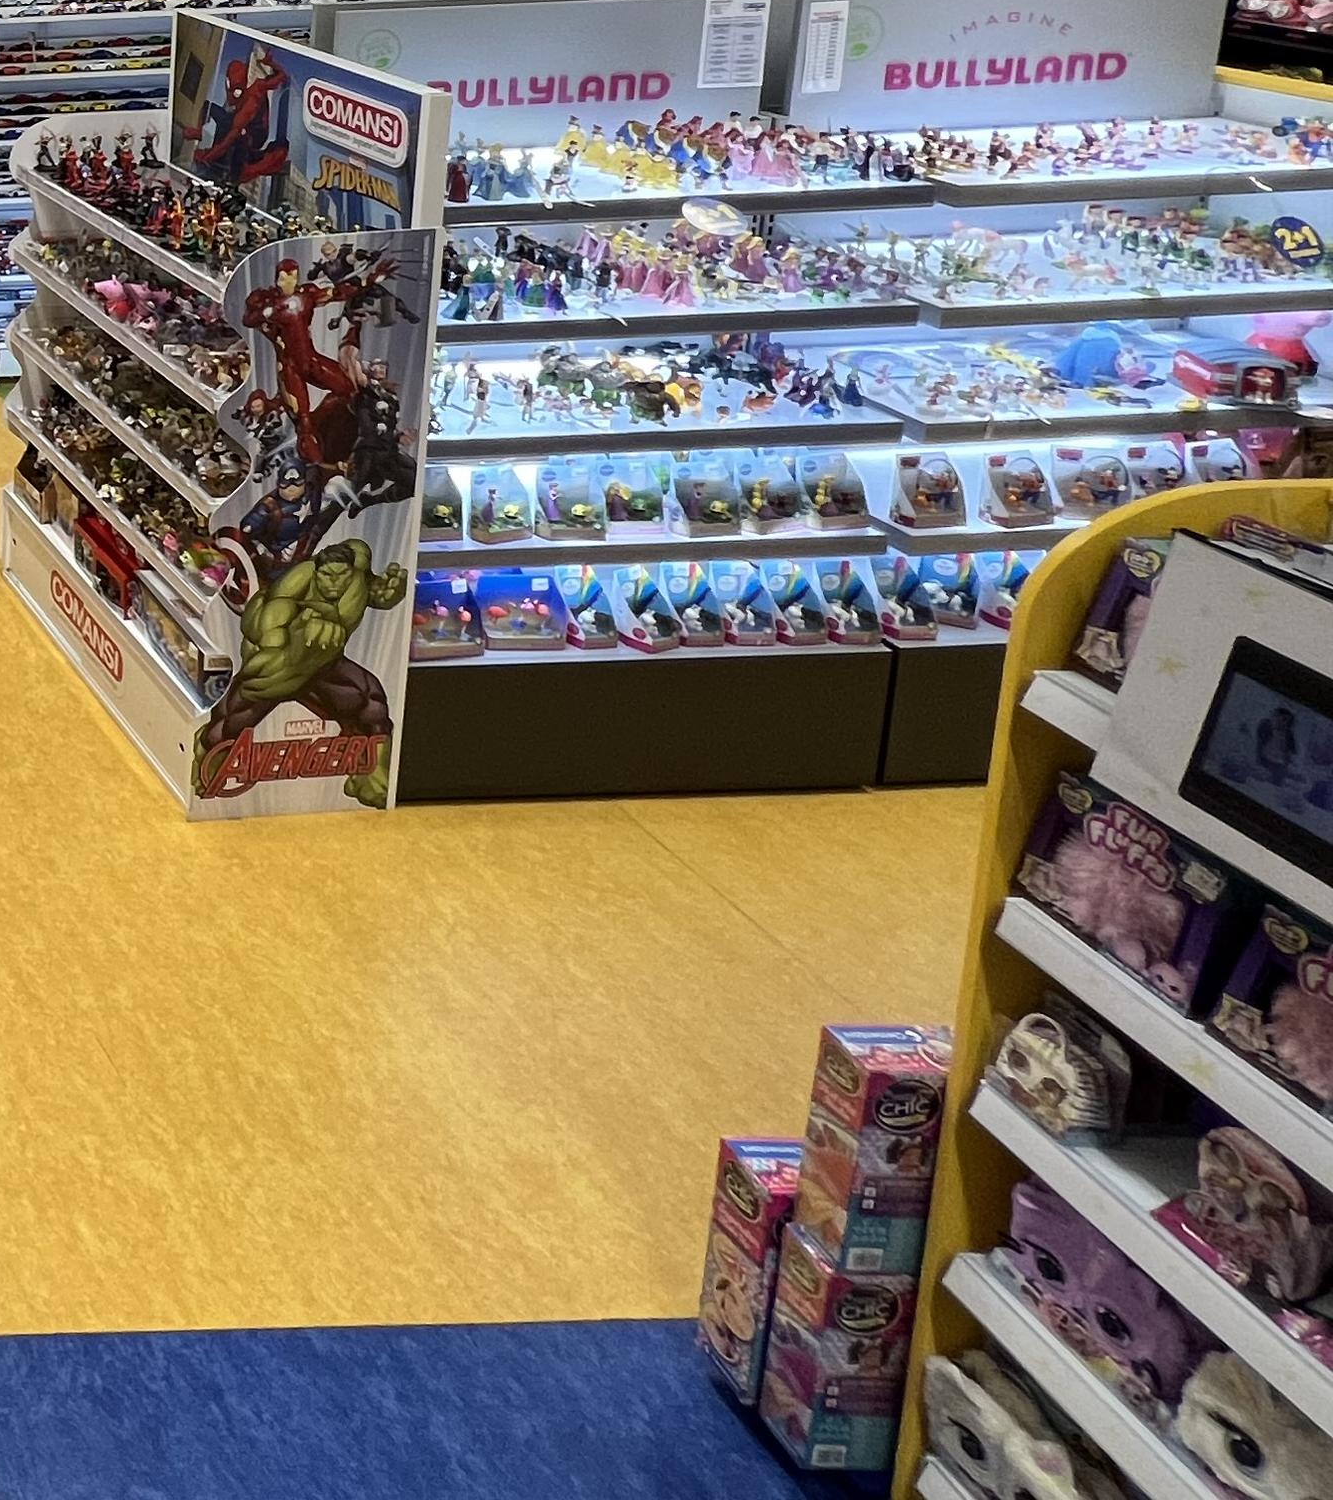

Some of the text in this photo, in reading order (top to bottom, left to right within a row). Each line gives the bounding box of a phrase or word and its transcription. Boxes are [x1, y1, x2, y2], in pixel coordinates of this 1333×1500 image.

[949, 10, 1074, 44] IMAGINE
[882, 52, 1129, 91] BULLYLAND
[309, 89, 399, 146] COMANSI
[1274, 226, 1319, 250] 2+1
[52, 575, 120, 678] COMANSI
[285, 720, 325, 736] MARVEL
[200, 727, 389, 799] AVENGERS
[1112, 807, 1167, 849] FUR
[879, 1098, 931, 1117] CHIC
